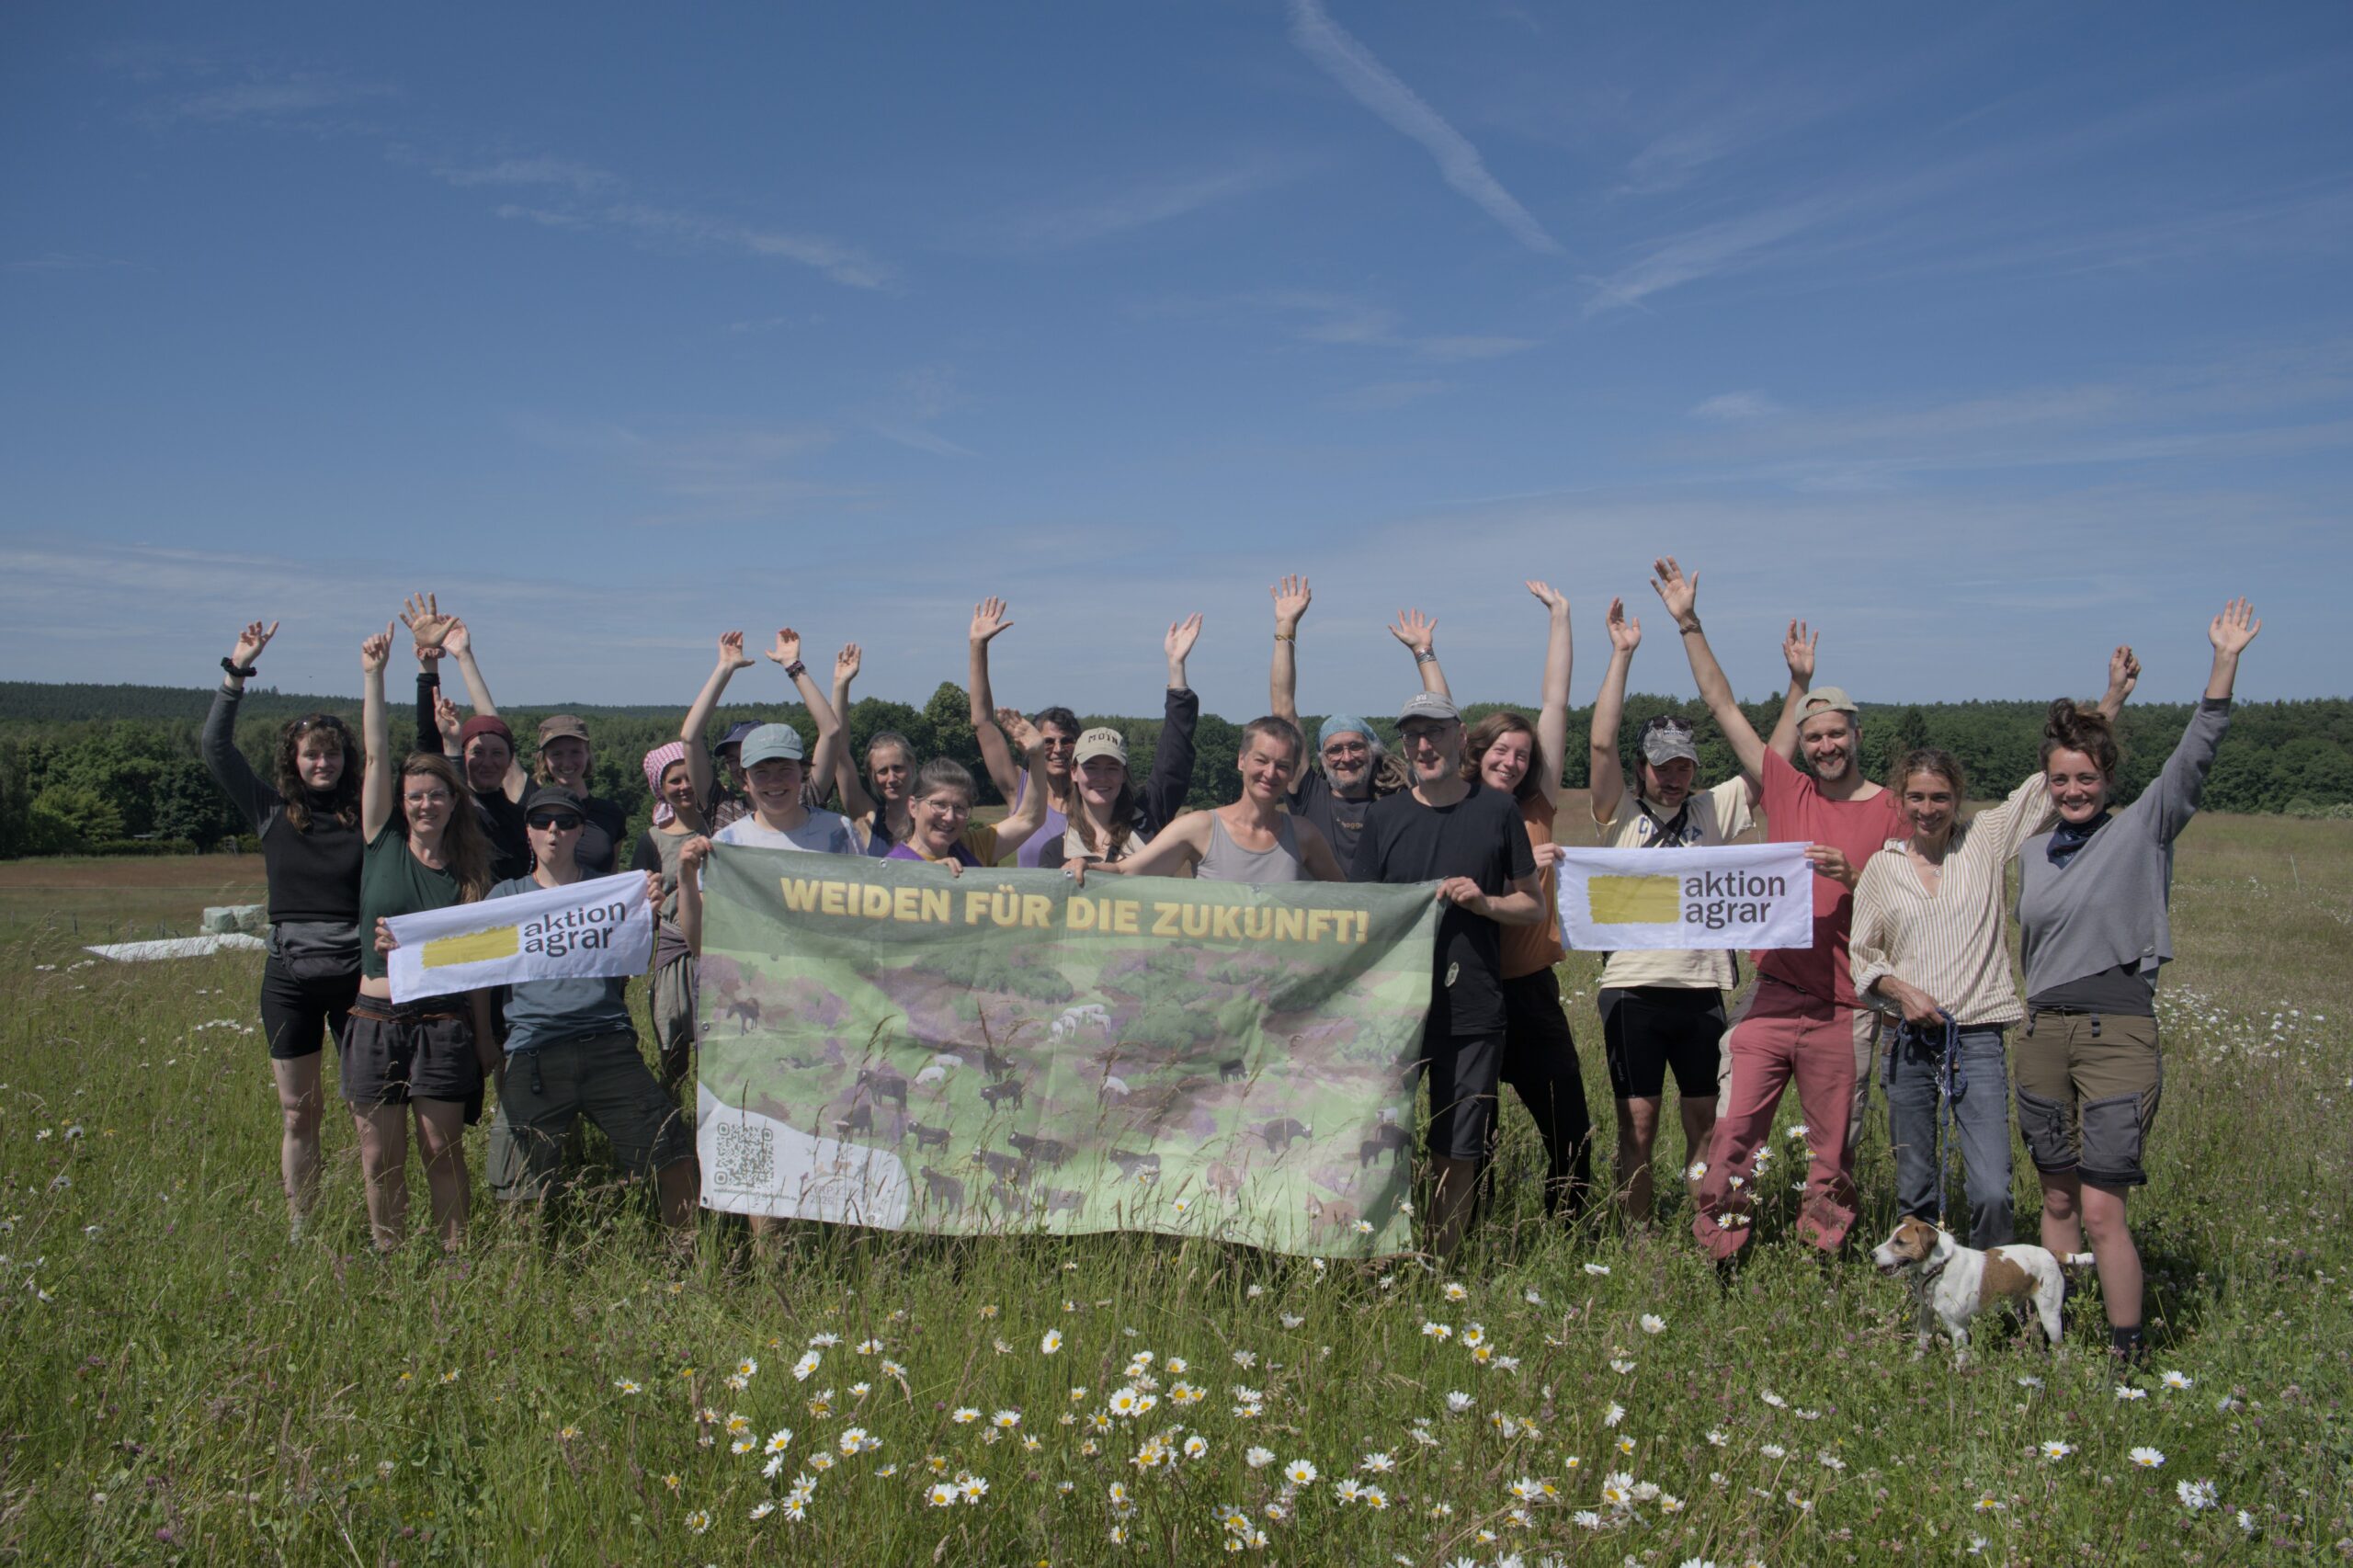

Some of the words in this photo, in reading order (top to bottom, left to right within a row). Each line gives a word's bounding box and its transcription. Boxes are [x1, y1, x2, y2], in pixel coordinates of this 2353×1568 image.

[1087, 733, 1118, 745] MOIN
[1685, 870, 1785, 897] aktion
[524, 902, 626, 937] aktion
[780, 878, 951, 923] WEIDEN
[965, 884, 1054, 928] FÜR
[1066, 896, 1142, 934] DIE
[1151, 902, 1370, 944] ZUKUNFT!
[1685, 899, 1771, 929] agrar
[525, 926, 613, 958] agrar
